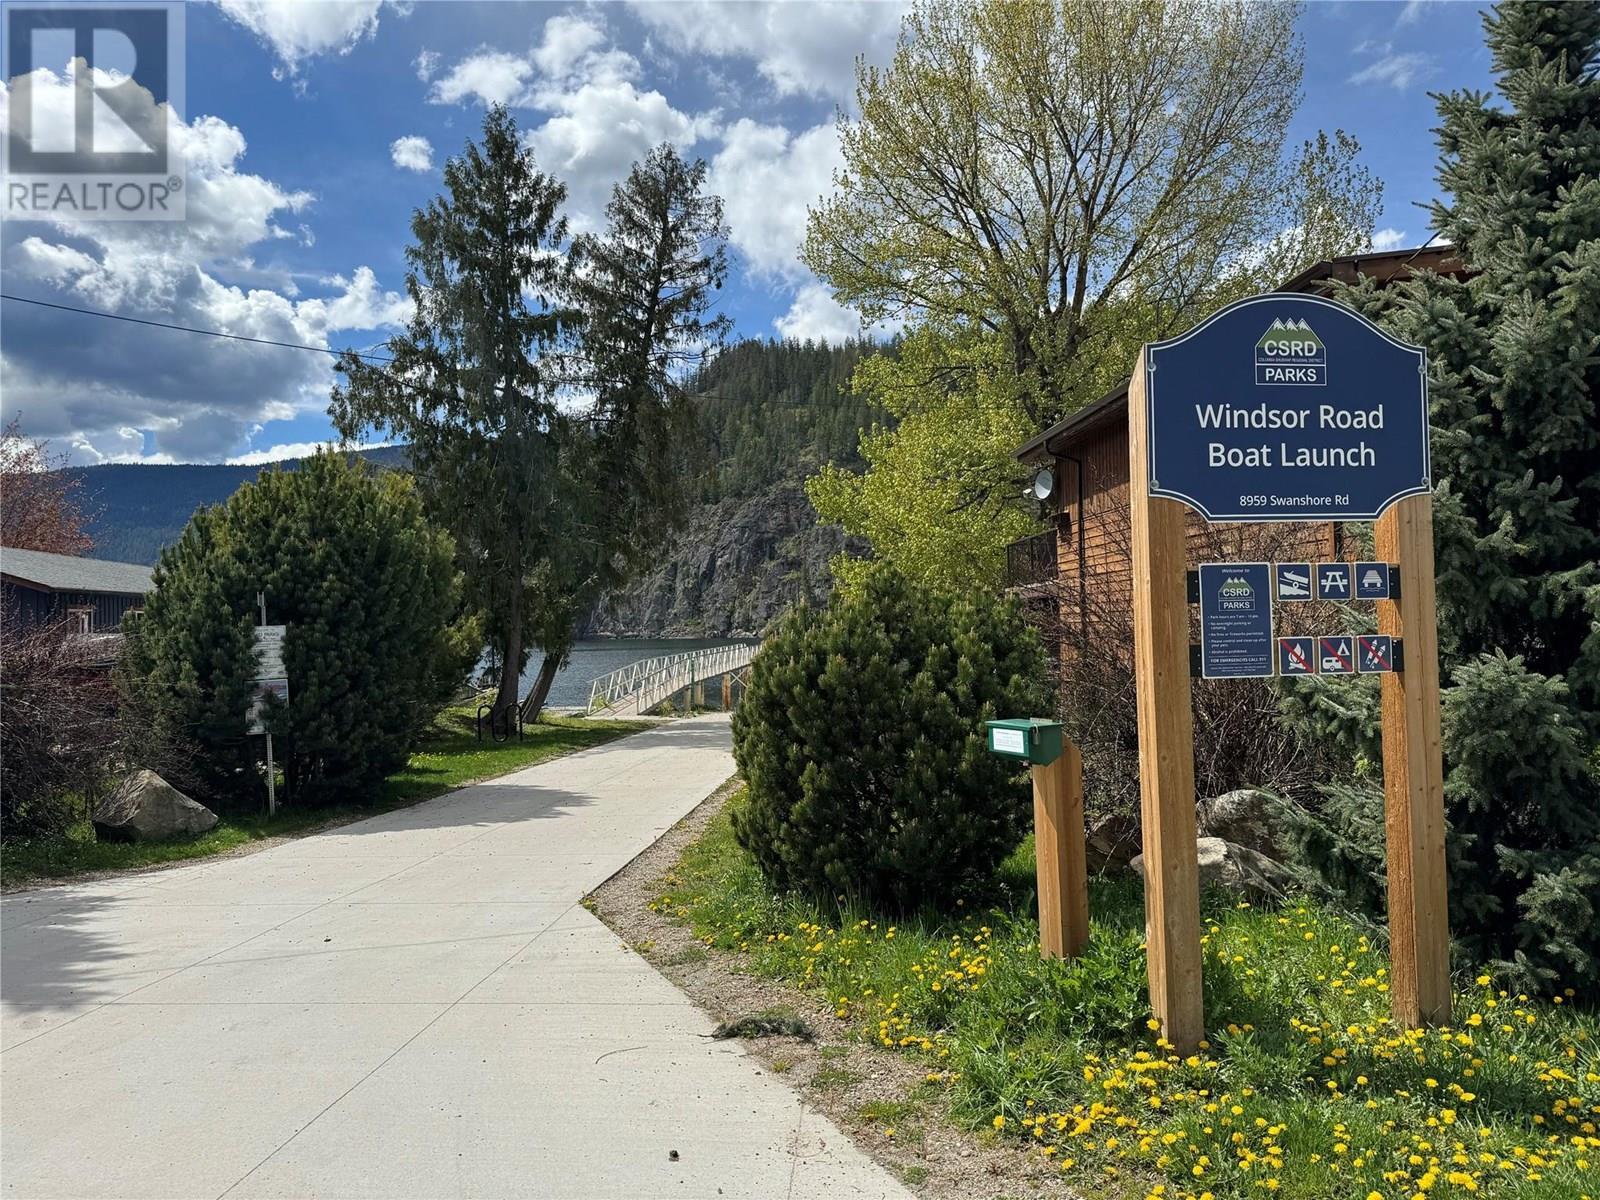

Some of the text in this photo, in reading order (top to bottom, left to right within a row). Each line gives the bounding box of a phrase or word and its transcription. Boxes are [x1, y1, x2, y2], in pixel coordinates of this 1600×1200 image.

[1264, 340, 1317, 356] CSRD
[1265, 368, 1317, 382] PARKS
[1195, 403, 1384, 429] Windsor Road
[1208, 442, 1376, 467] Boat Launch
[1239, 494, 1349, 506] 8959 Swanshore Rd
[1223, 588, 1250, 597] CSRD
